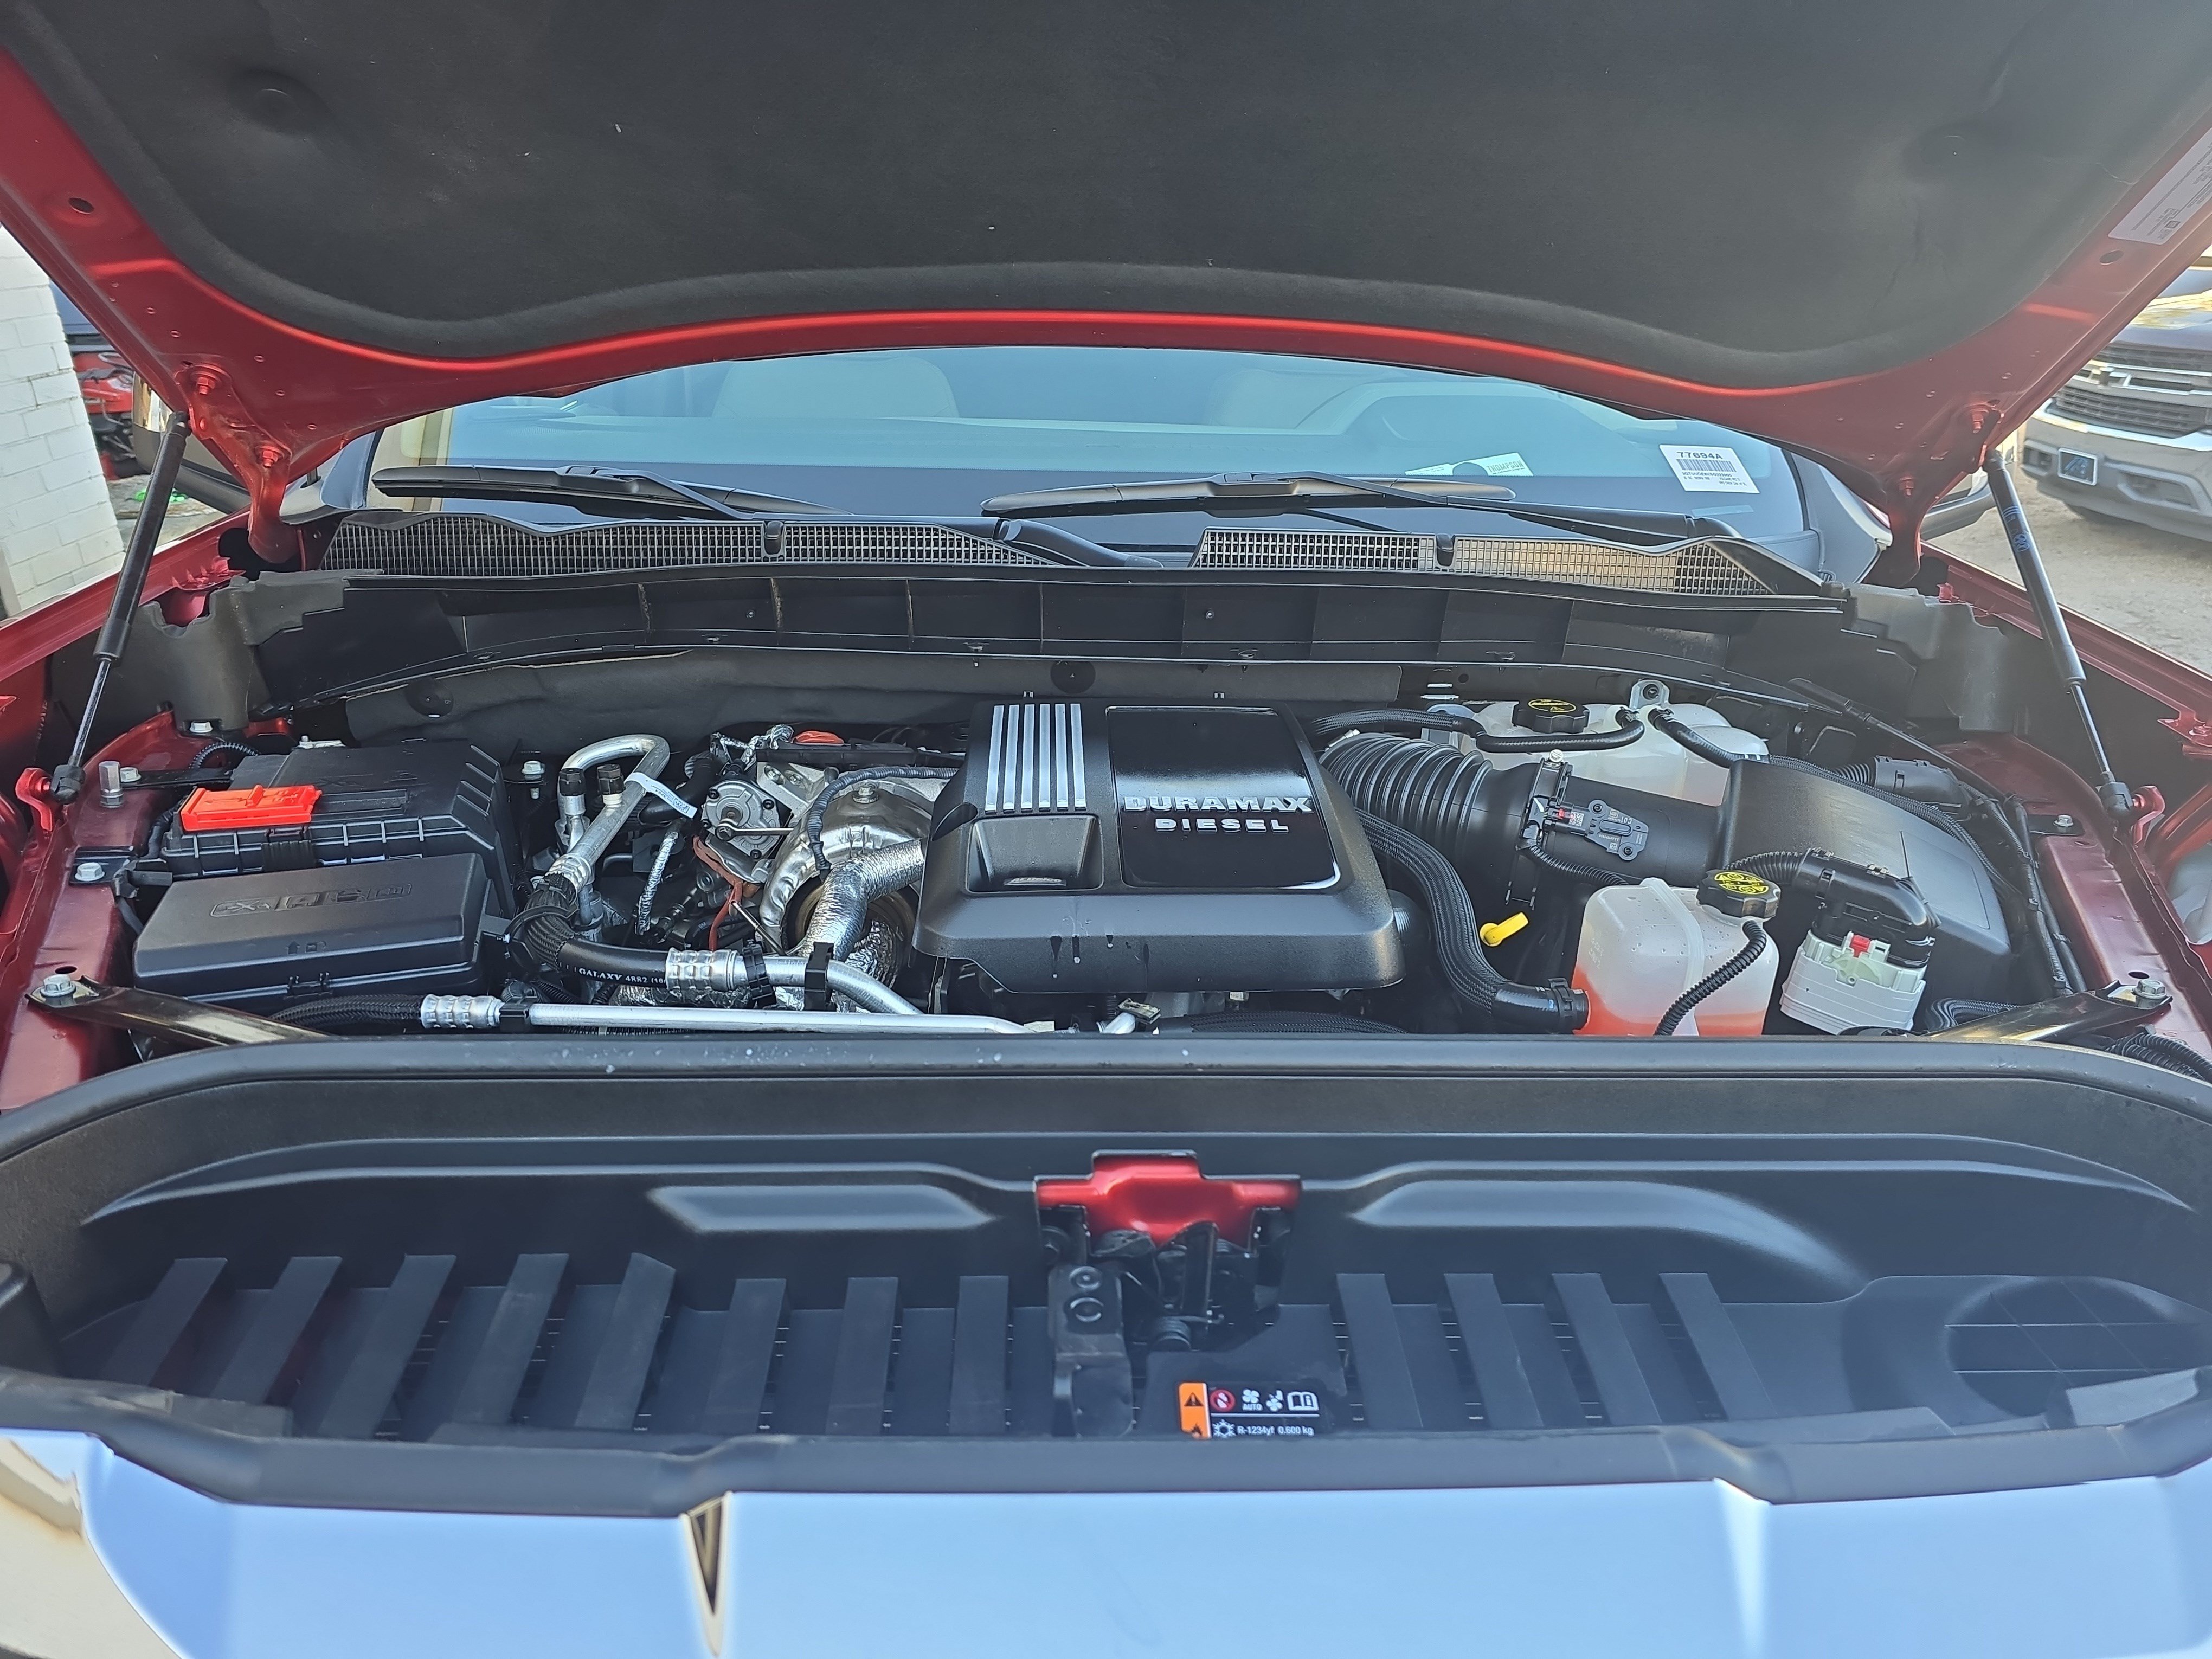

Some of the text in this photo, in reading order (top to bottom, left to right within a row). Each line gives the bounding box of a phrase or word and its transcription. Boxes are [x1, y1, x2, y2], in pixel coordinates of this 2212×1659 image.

[1487, 460, 1524, 473] THOMPSON
[1123, 796, 1314, 813] DURAMAX
[1155, 818, 1289, 833] DIESEL
[578, 968, 623, 981] GALAXY
[625, 975, 648, 983] 4882
[1237, 1425, 1315, 1437] R-1234yf 0.600 kg
